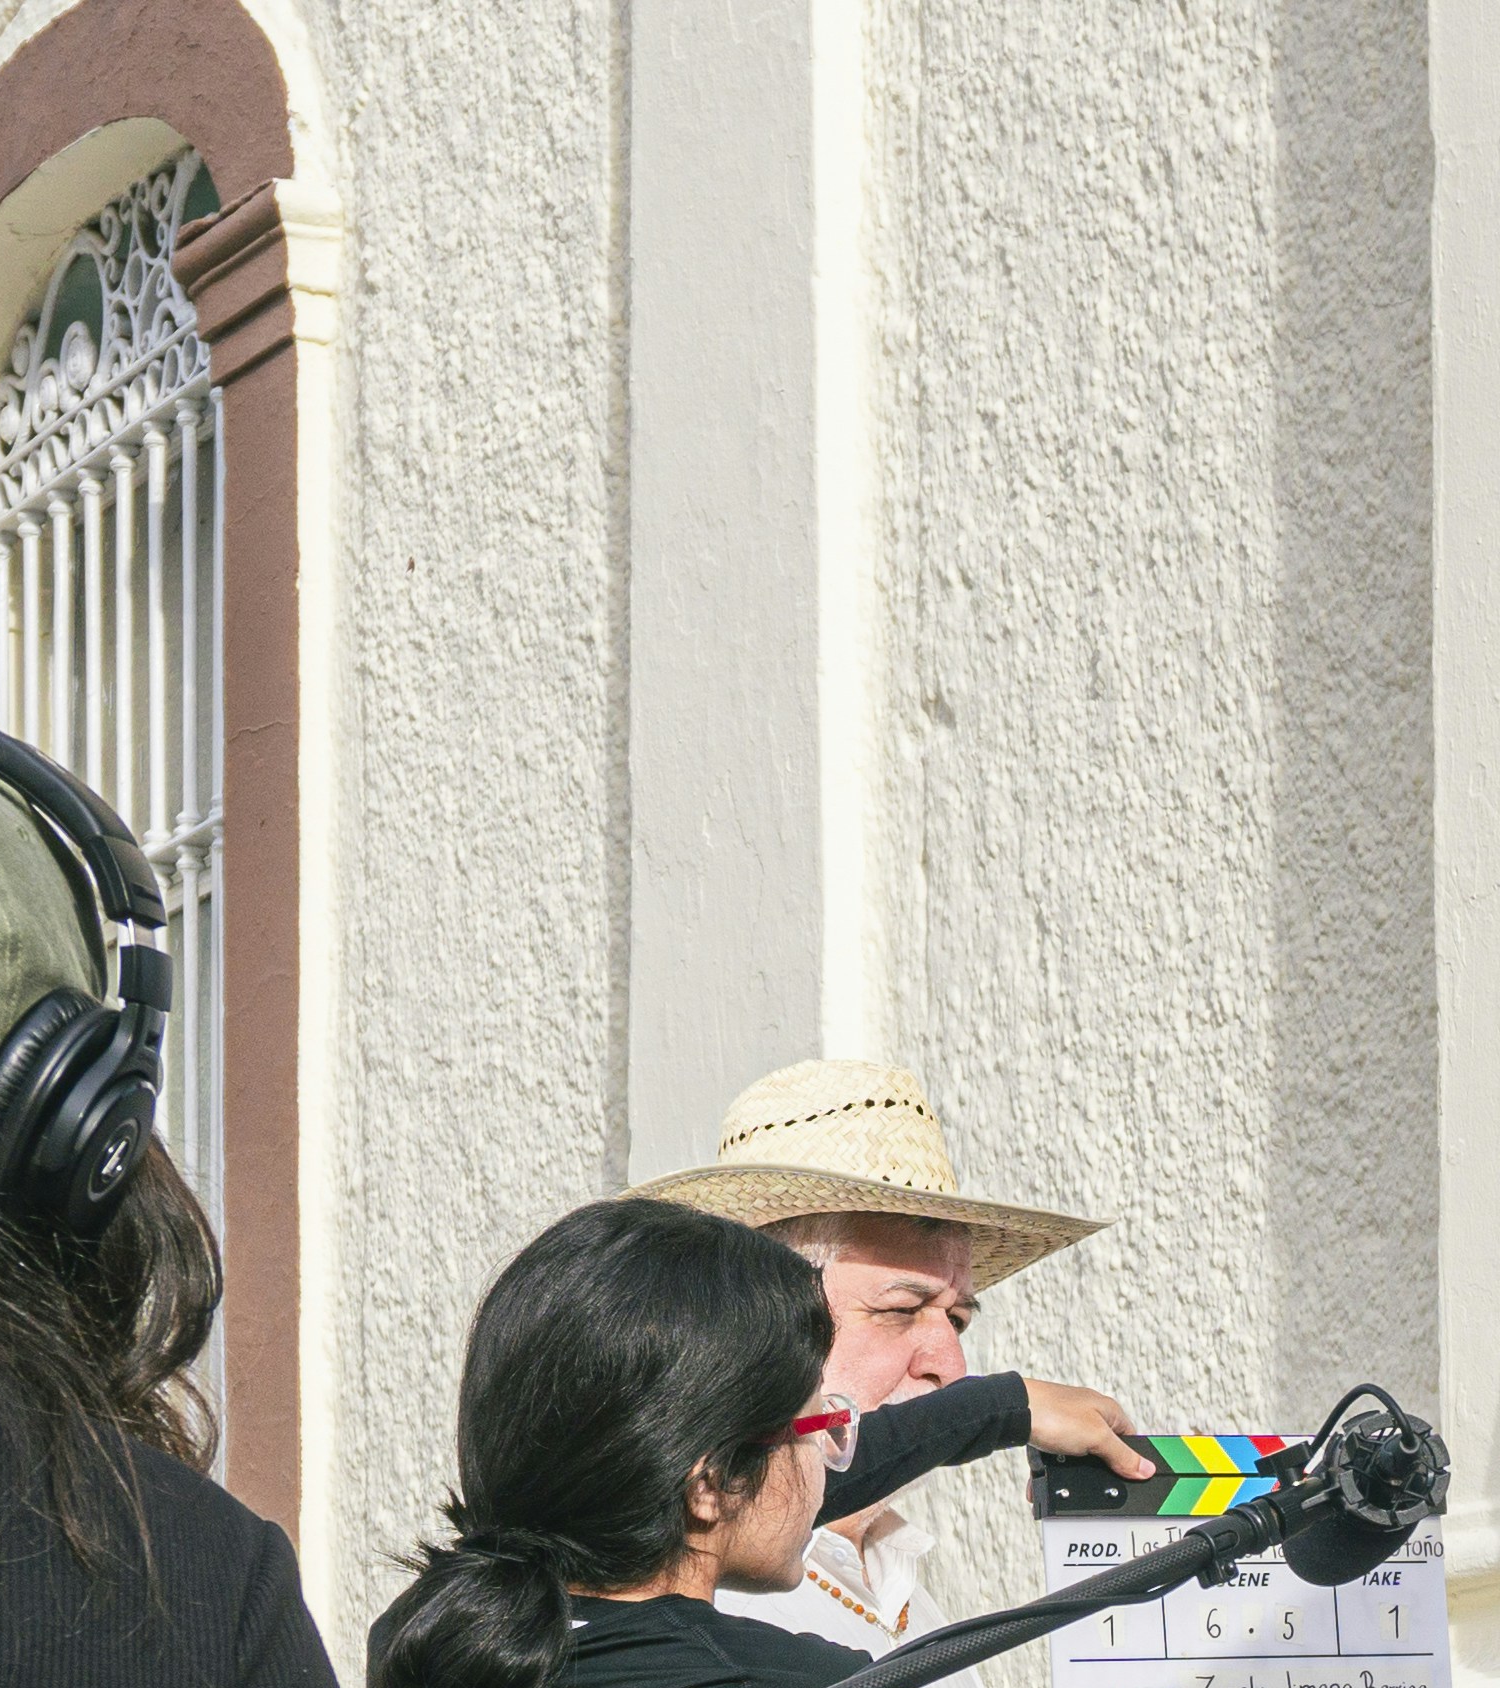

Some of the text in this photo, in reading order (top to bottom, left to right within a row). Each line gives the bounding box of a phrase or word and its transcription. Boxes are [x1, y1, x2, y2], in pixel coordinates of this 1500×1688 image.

[1067, 1542, 1121, 1558] PROD.
[1217, 1572, 1270, 1588] ENE
[1102, 1614, 1114, 1647] 1
[1387, 1604, 1399, 1639] 1
